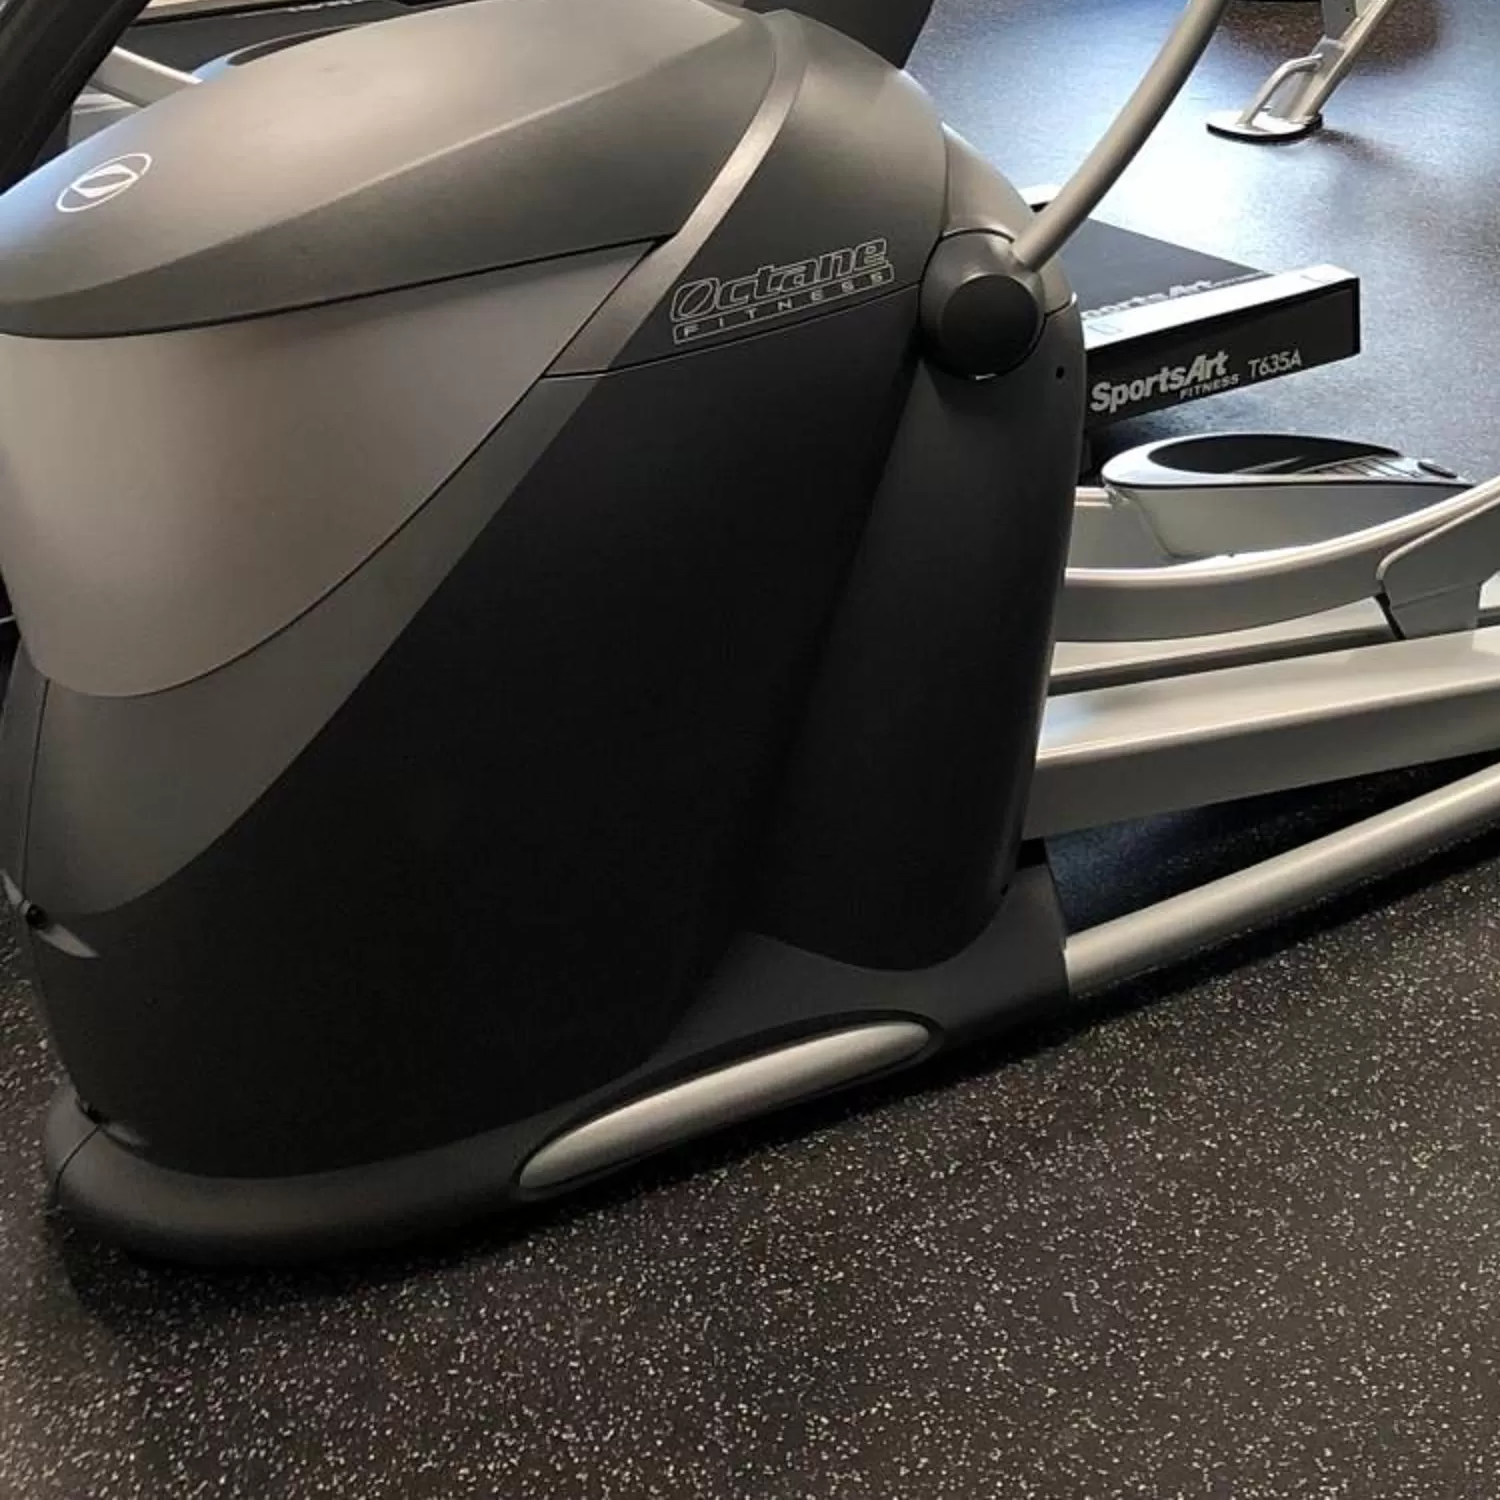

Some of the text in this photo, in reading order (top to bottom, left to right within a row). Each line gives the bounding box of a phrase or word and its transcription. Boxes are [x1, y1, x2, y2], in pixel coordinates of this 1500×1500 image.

[670, 238, 889, 322] Octane
[683, 272, 886, 338] FITNESS
[1090, 348, 1302, 413] SportsArt T635A
[1180, 373, 1240, 399] FITNESS
